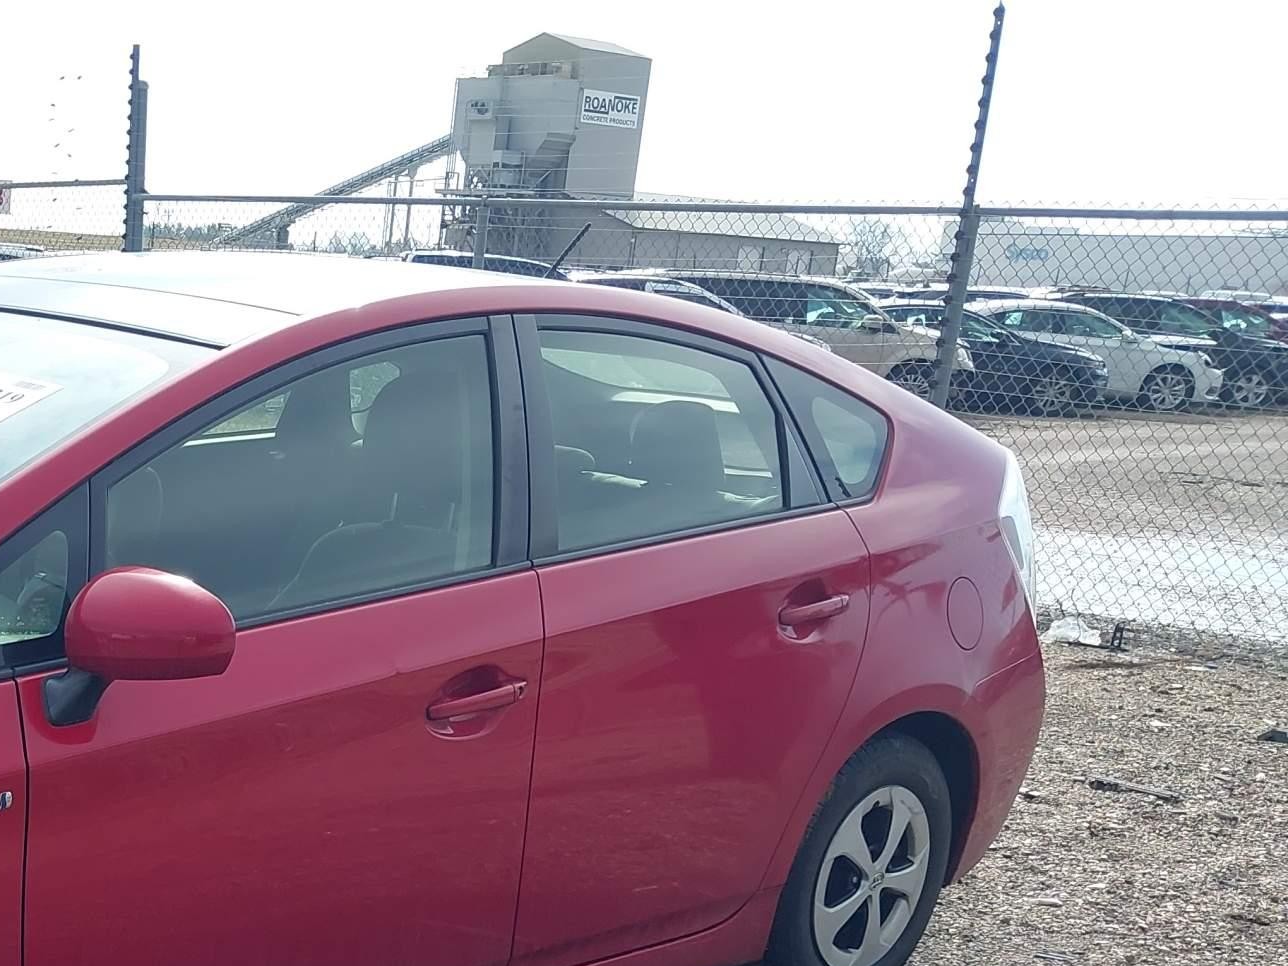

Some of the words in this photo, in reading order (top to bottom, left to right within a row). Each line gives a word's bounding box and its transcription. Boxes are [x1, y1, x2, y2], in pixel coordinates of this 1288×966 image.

[584, 95, 638, 115] ROANOKE
[582, 114, 608, 124] CONCRETE
[609, 117, 636, 127] PRODUCTS
